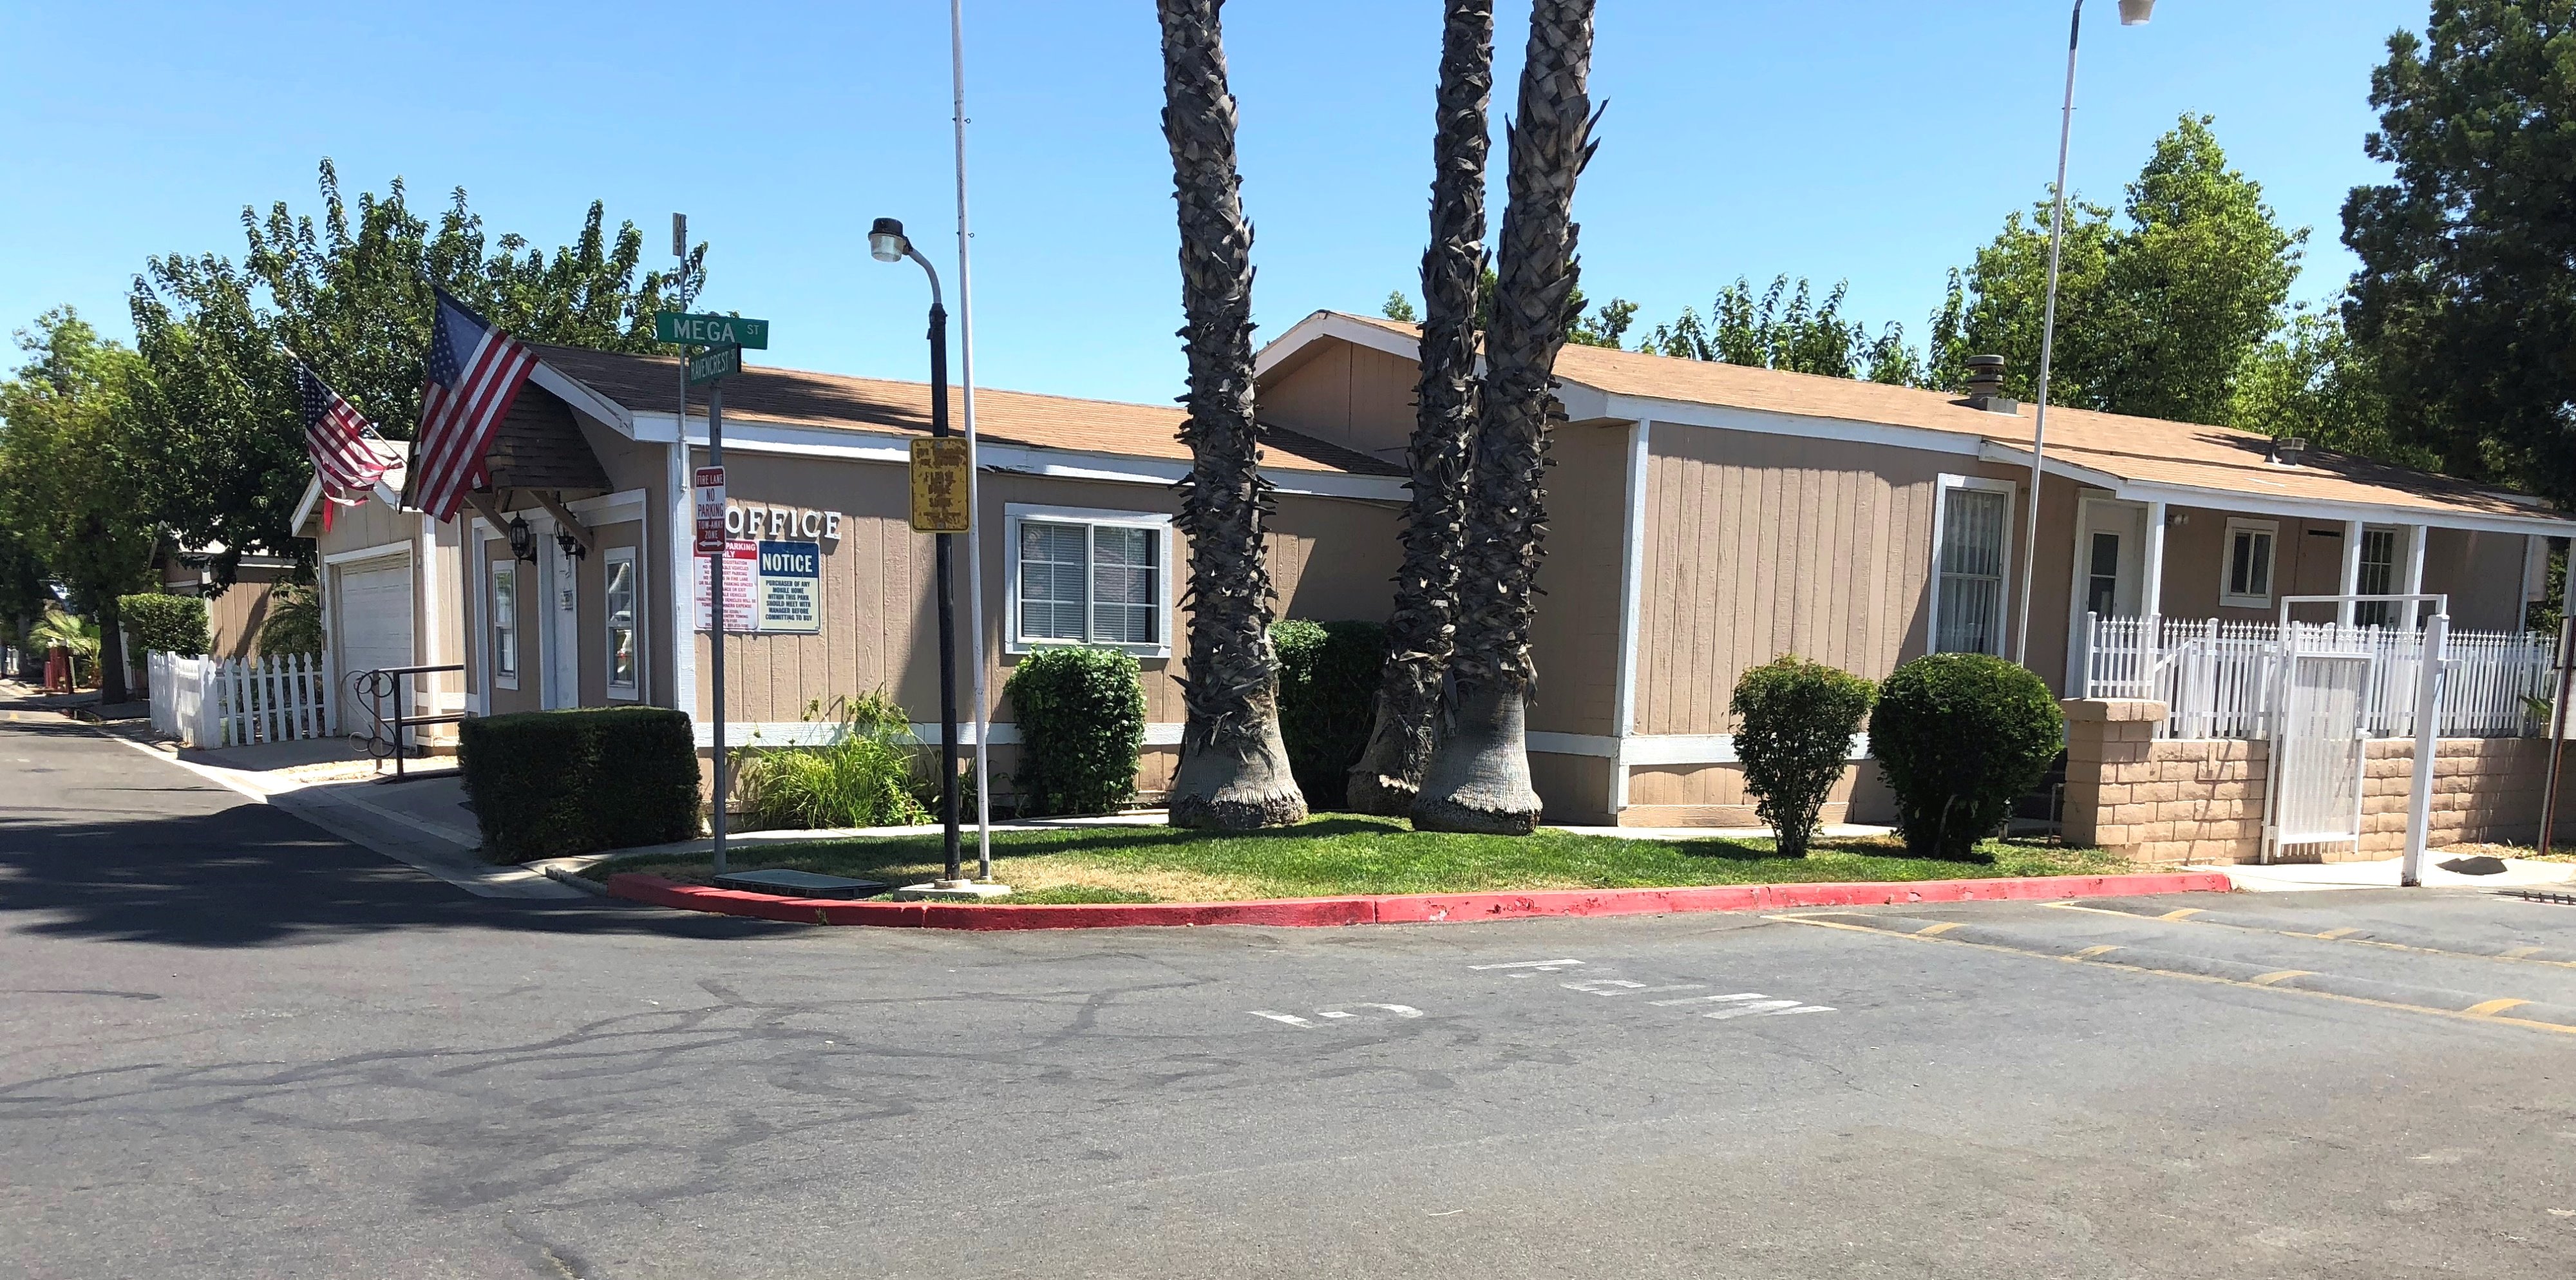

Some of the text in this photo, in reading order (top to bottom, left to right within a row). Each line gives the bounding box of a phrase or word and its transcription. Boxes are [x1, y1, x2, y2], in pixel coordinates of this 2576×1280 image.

[674, 318, 759, 343] MEGA ST
[690, 350, 729, 381] RAVENCREST
[697, 473, 723, 485] FIRE LANE
[706, 488, 715, 502] NO
[697, 503, 724, 517] PARKING
[698, 520, 723, 530] TOW-AWAY
[724, 506, 842, 539] OFFICE
[705, 530, 718, 539] ZONE
[725, 542, 756, 551] PARKING
[762, 553, 813, 573] NOTICE
